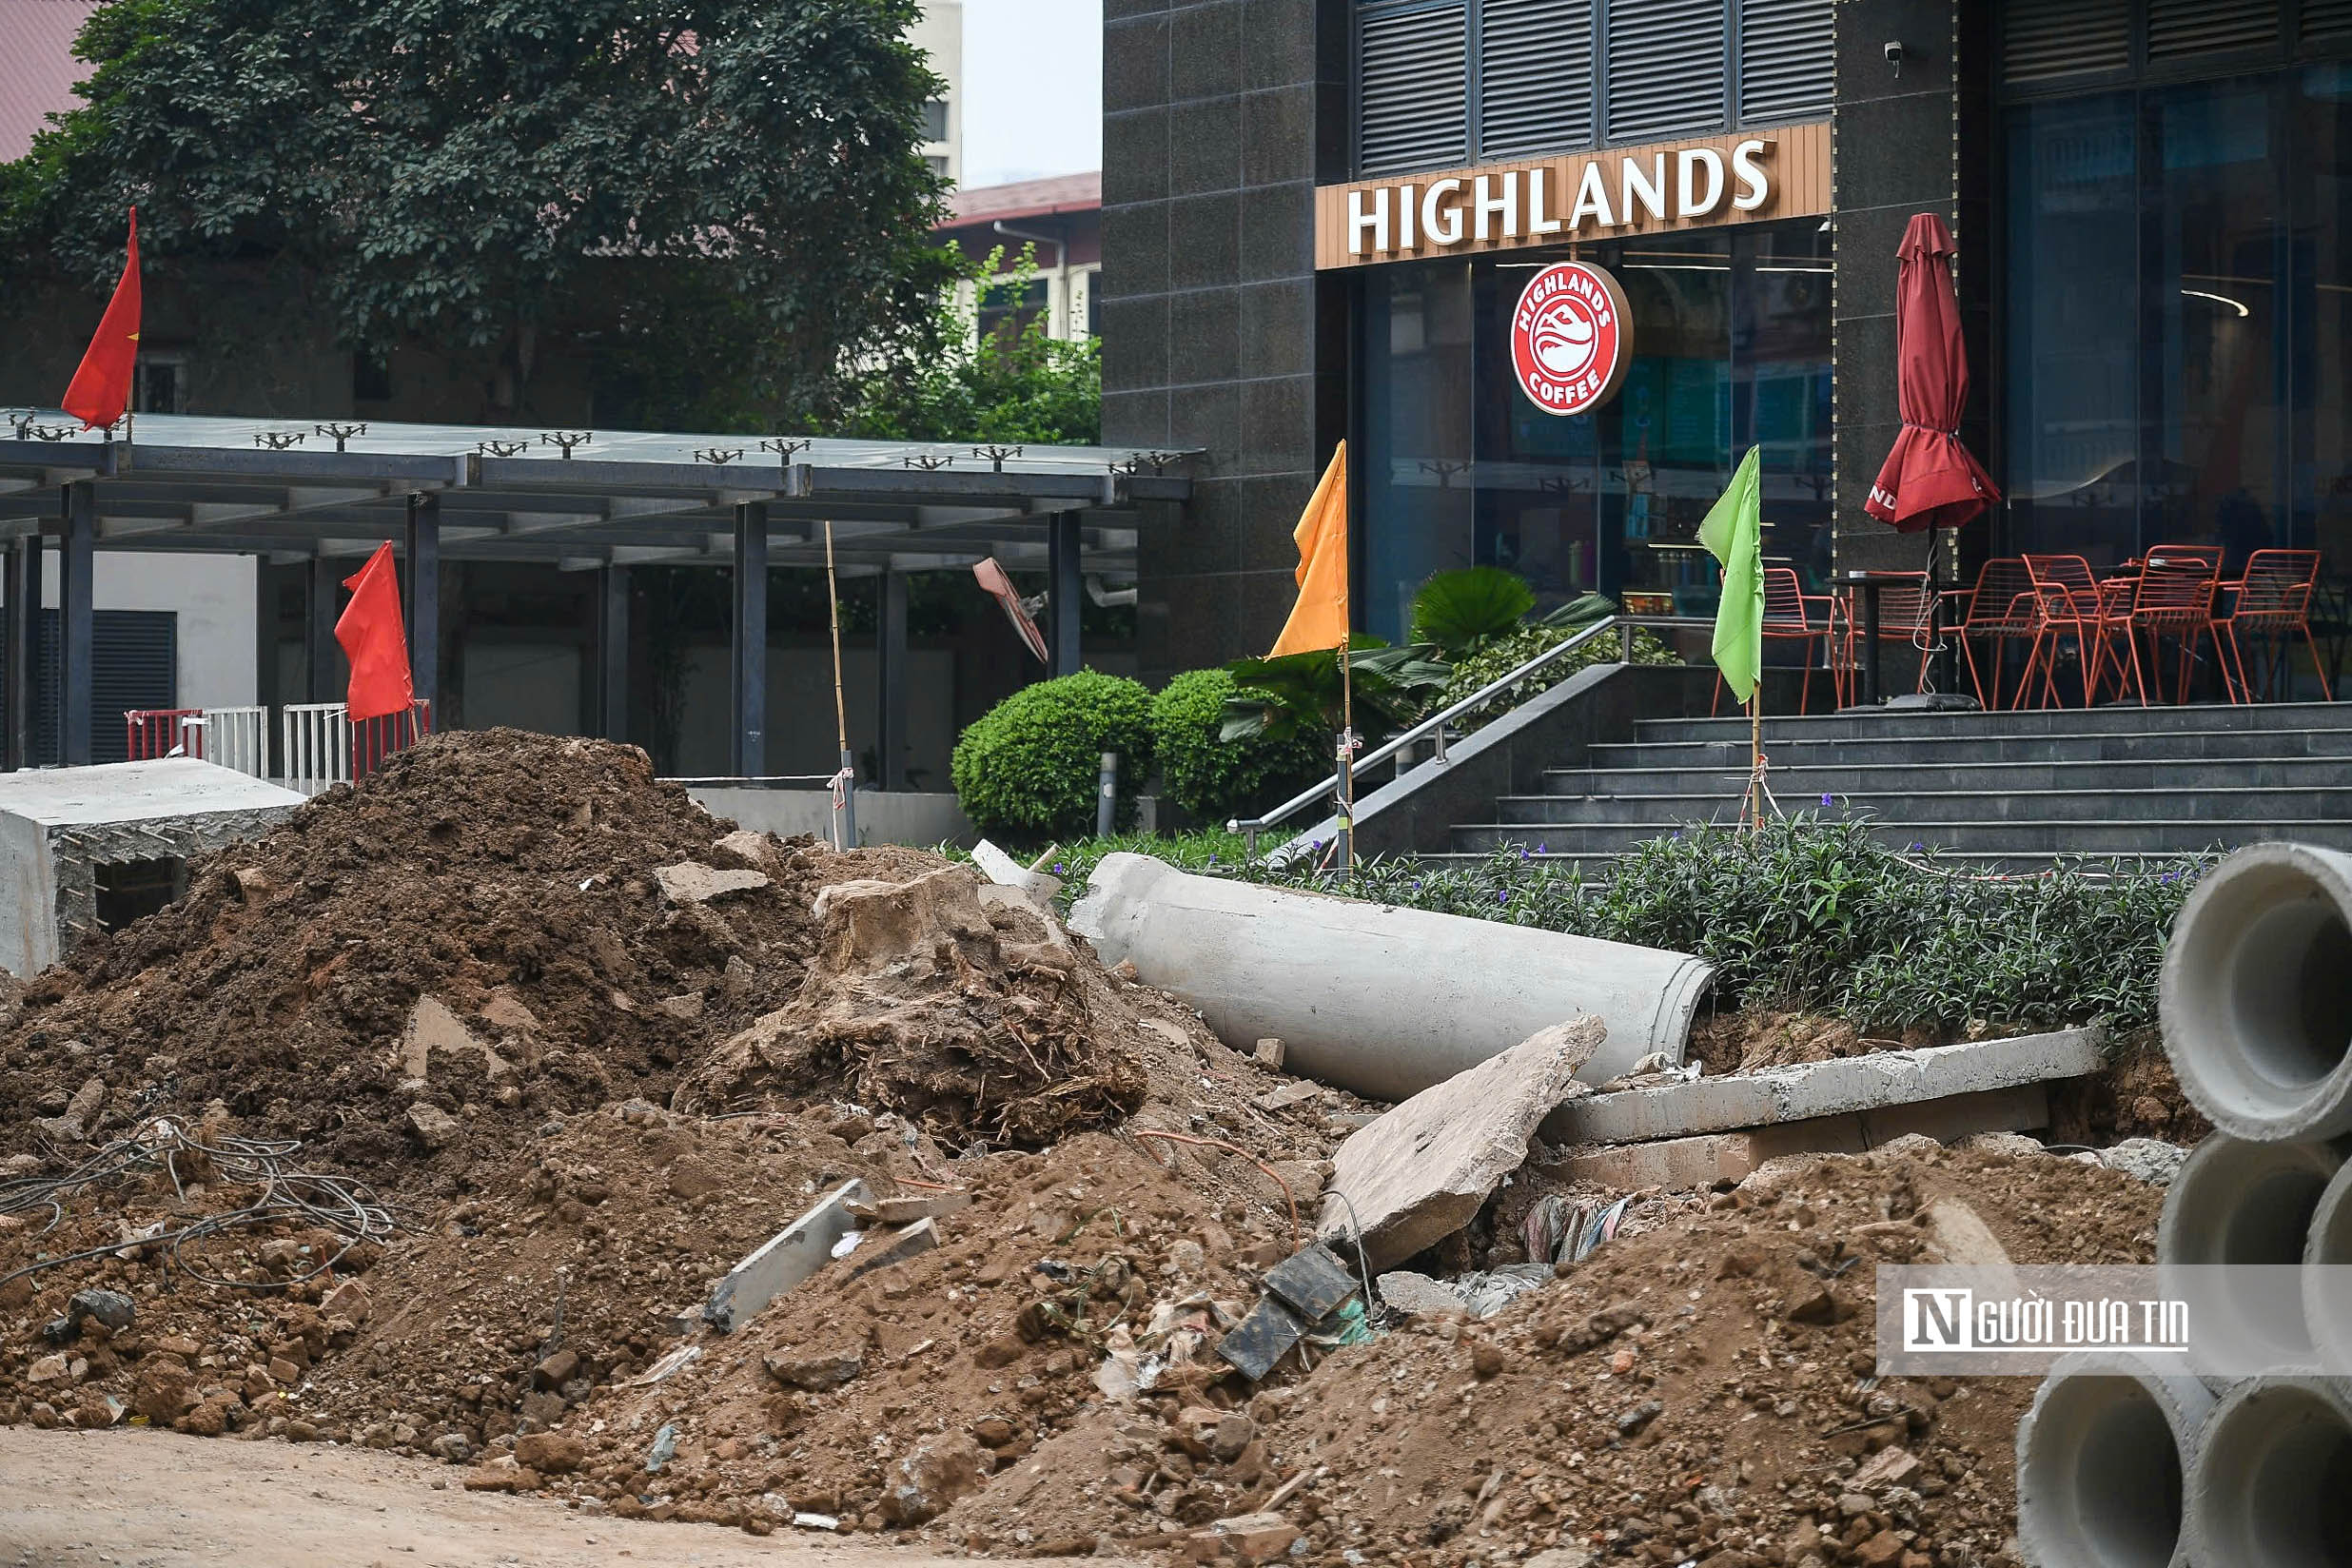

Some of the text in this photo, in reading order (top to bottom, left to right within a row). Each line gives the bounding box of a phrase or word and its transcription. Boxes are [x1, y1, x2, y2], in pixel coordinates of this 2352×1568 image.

[1347, 139, 1776, 256] HIGHLANDS
[1518, 272, 1611, 333] HIGHLANDS
[1528, 368, 1600, 404] COFFEE
